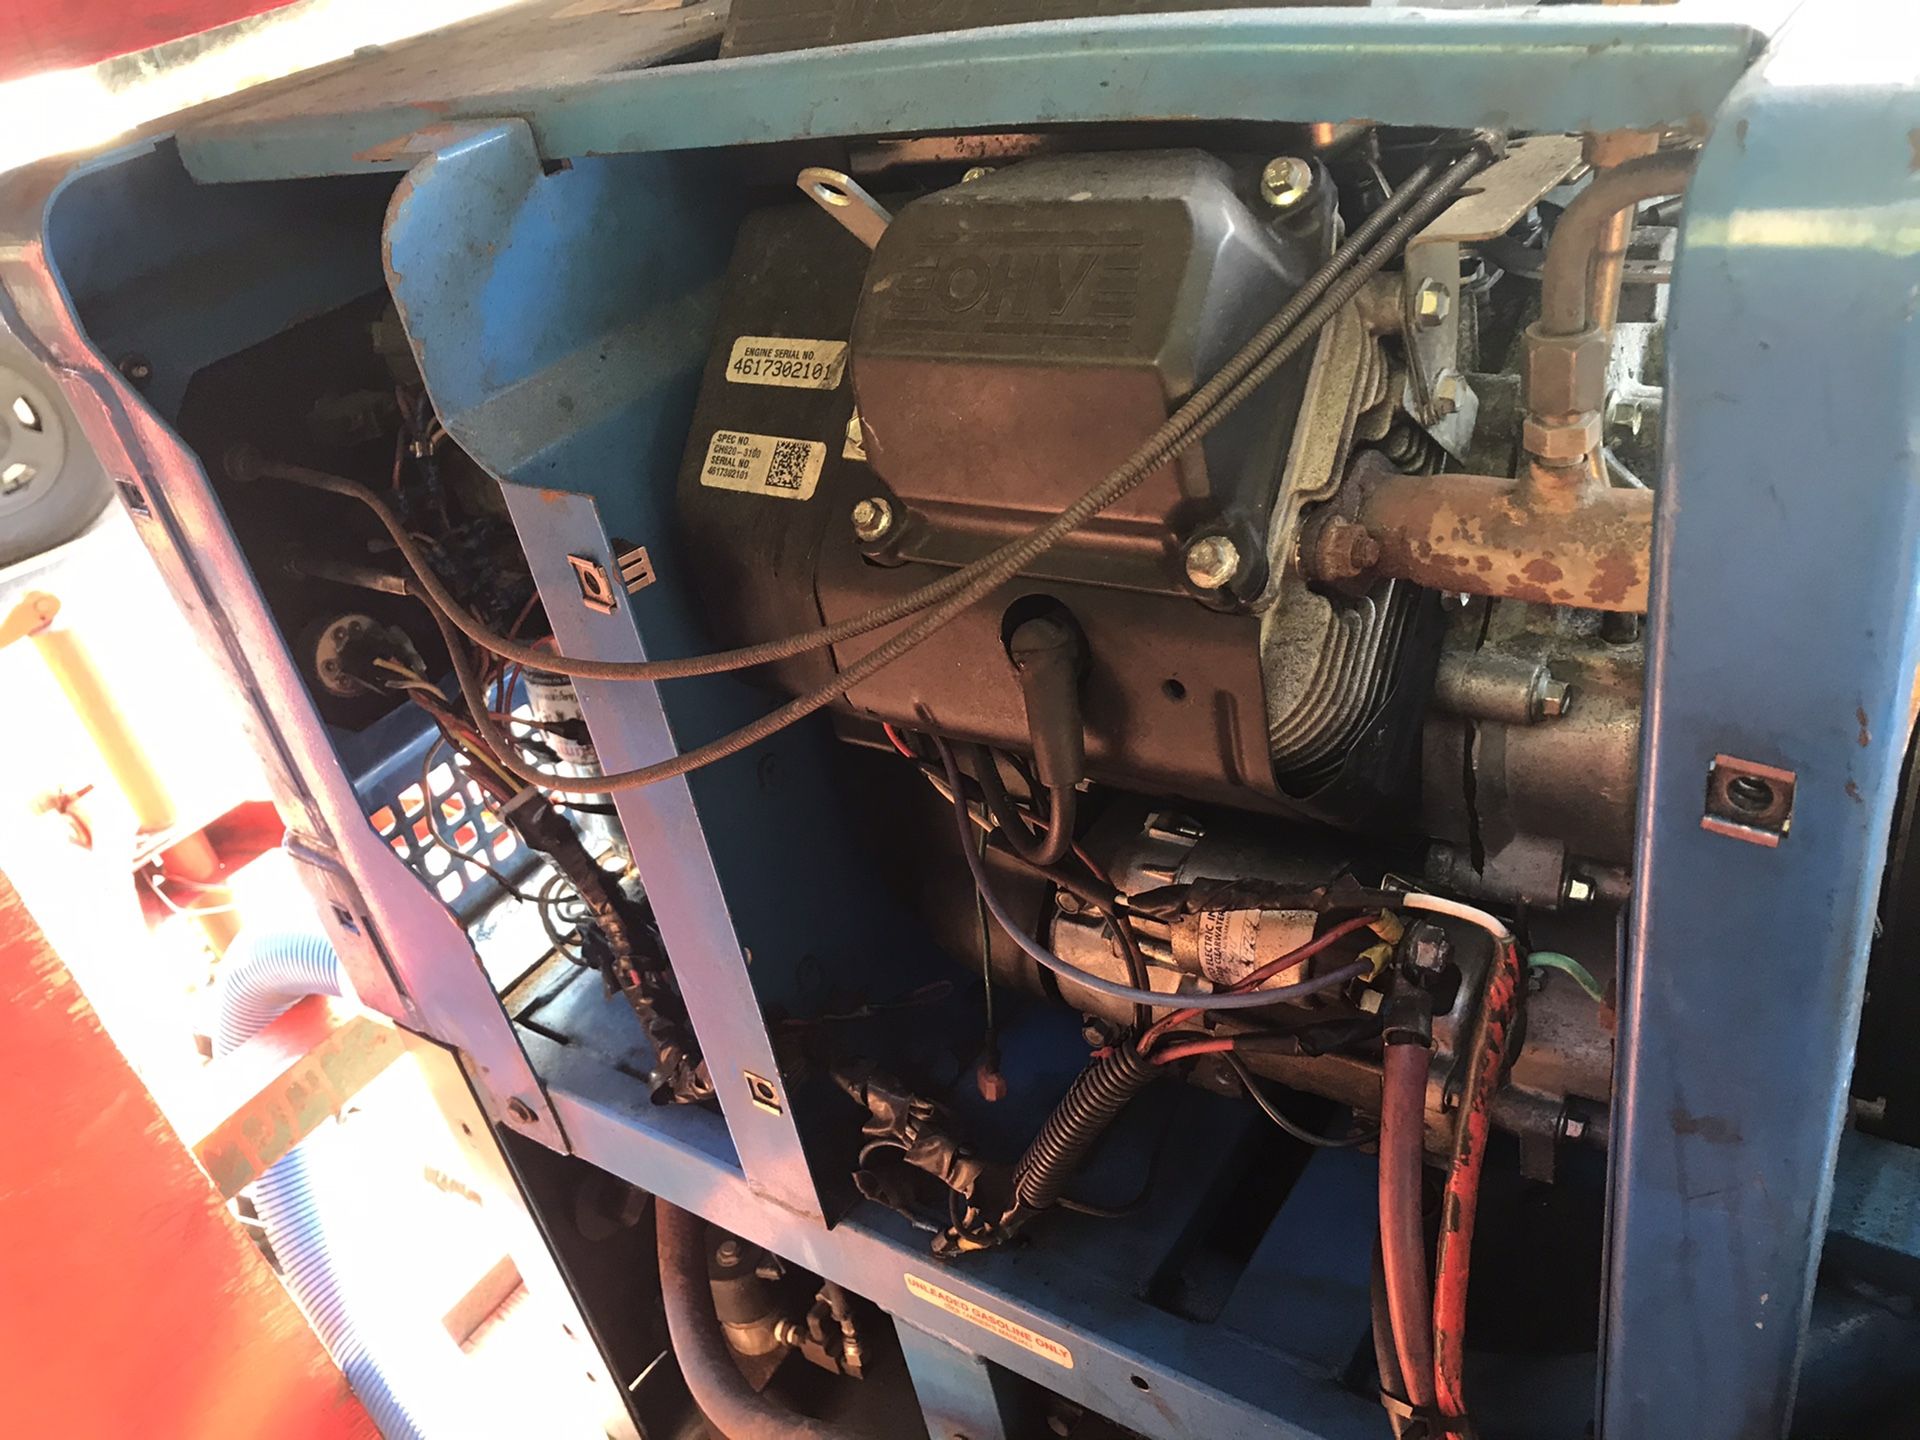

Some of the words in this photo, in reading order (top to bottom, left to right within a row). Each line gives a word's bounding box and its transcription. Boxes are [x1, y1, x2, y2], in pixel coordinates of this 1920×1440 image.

[744, 347, 774, 358] ENGINE
[774, 349, 801, 360] SERIAL
[802, 350, 816, 361] NO.
[733, 357, 832, 381] 4617302101
[717, 433, 737, 445] SPEC
[710, 455, 736, 467] SERIAL
[707, 466, 749, 480] 4617302101
[1204, 924, 1214, 967] ELECTRIC
[1213, 911, 1225, 965] CLEARWATER
[908, 1278, 969, 1312] UNLEADED
[971, 1307, 1033, 1342] GASOLINE
[1035, 1336, 1068, 1359] ONLY
